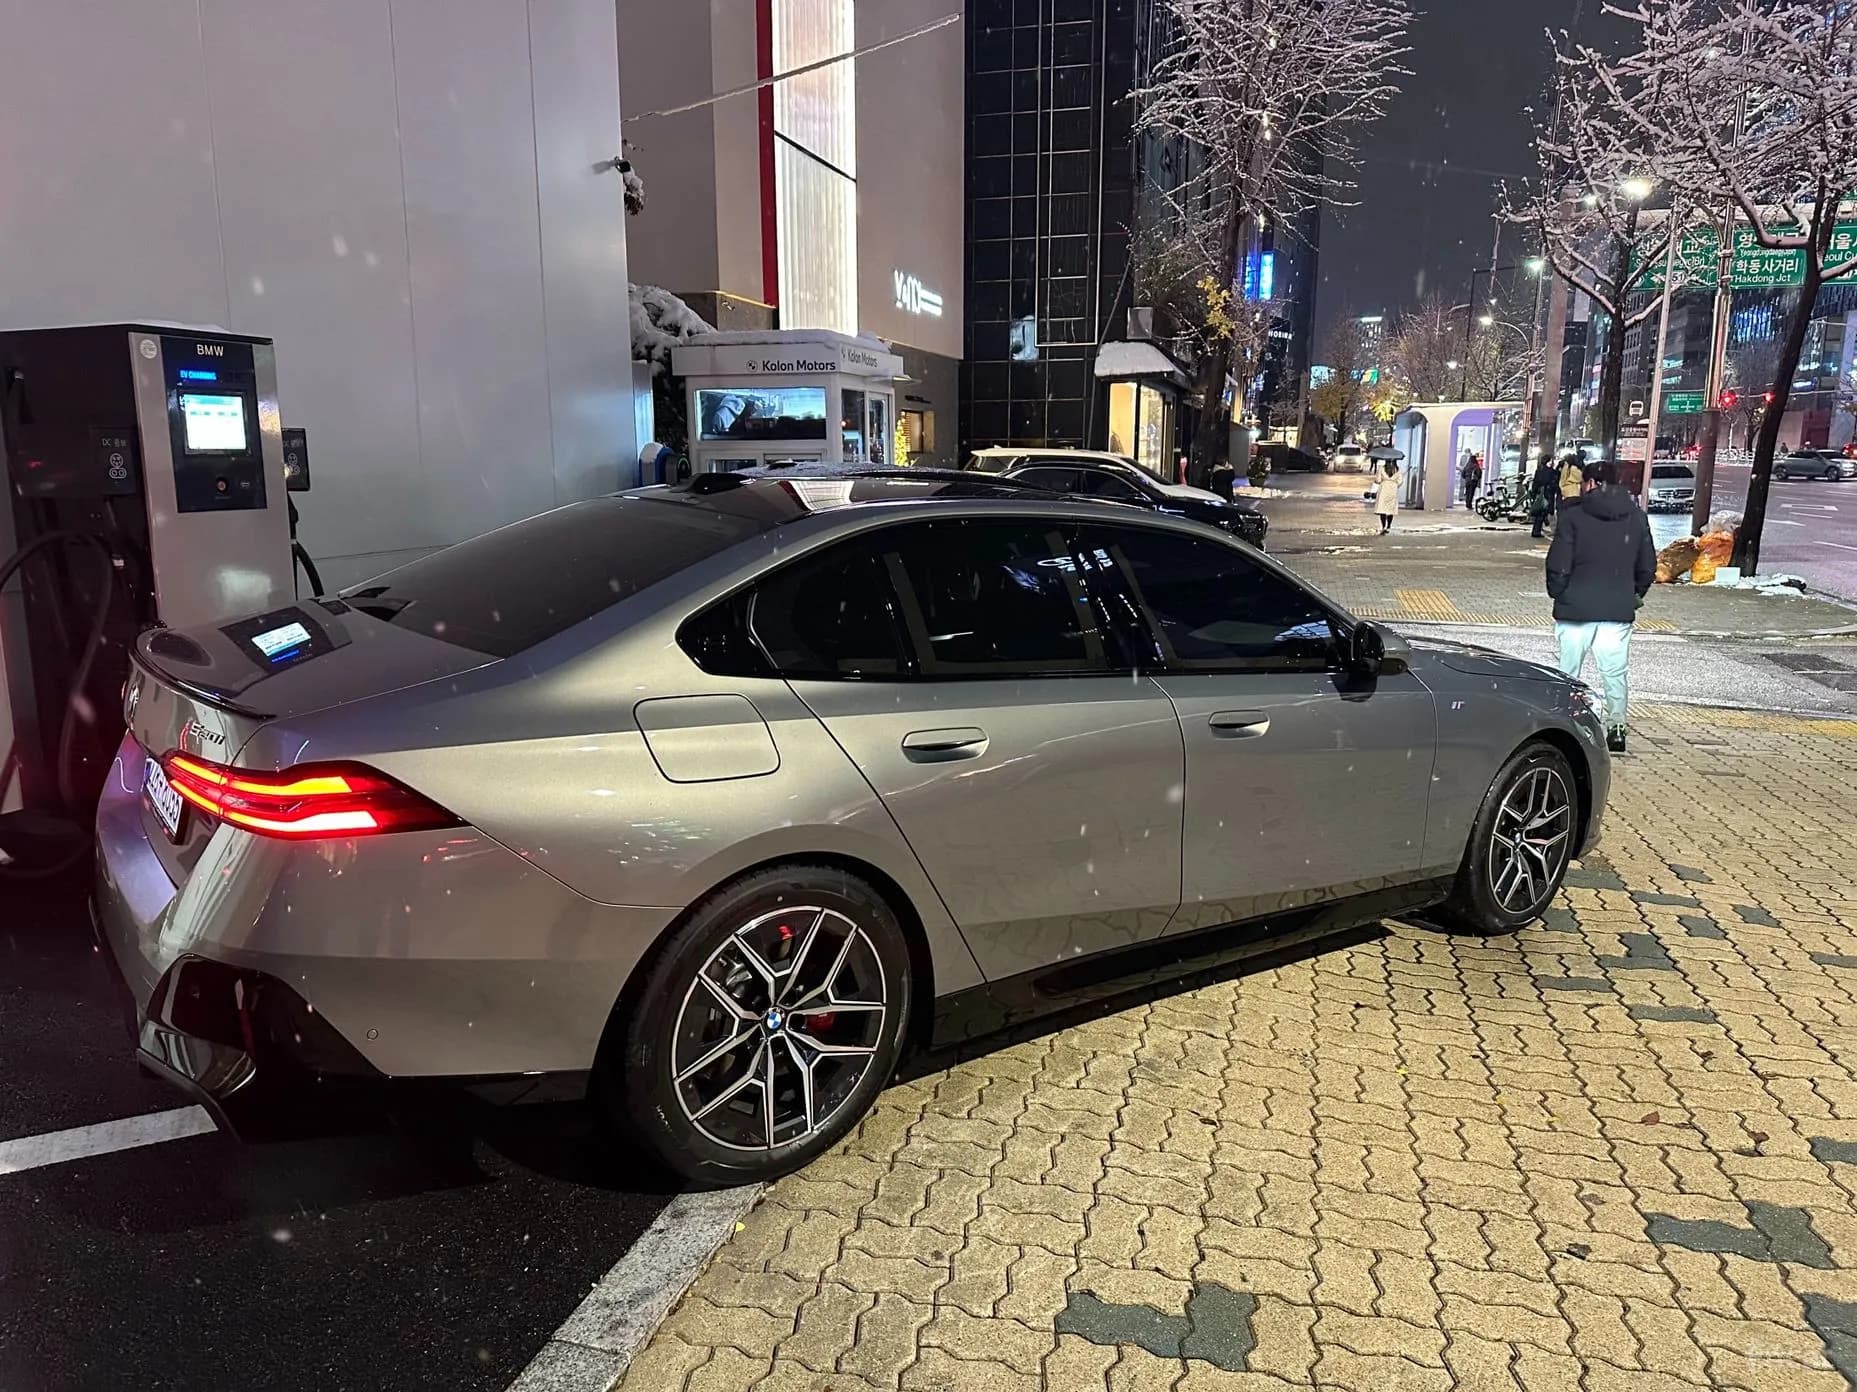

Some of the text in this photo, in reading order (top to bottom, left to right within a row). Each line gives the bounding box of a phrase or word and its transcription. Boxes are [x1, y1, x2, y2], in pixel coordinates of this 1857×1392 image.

[1736, 258, 1799, 274] 학동사거리
[1735, 273, 1791, 284] Hakdong Jct
[197, 344, 224, 357] BMW
[847, 349, 878, 368] Kolon Motors
[762, 360, 836, 372] Kolon Motors
[102, 438, 112, 446] DC
